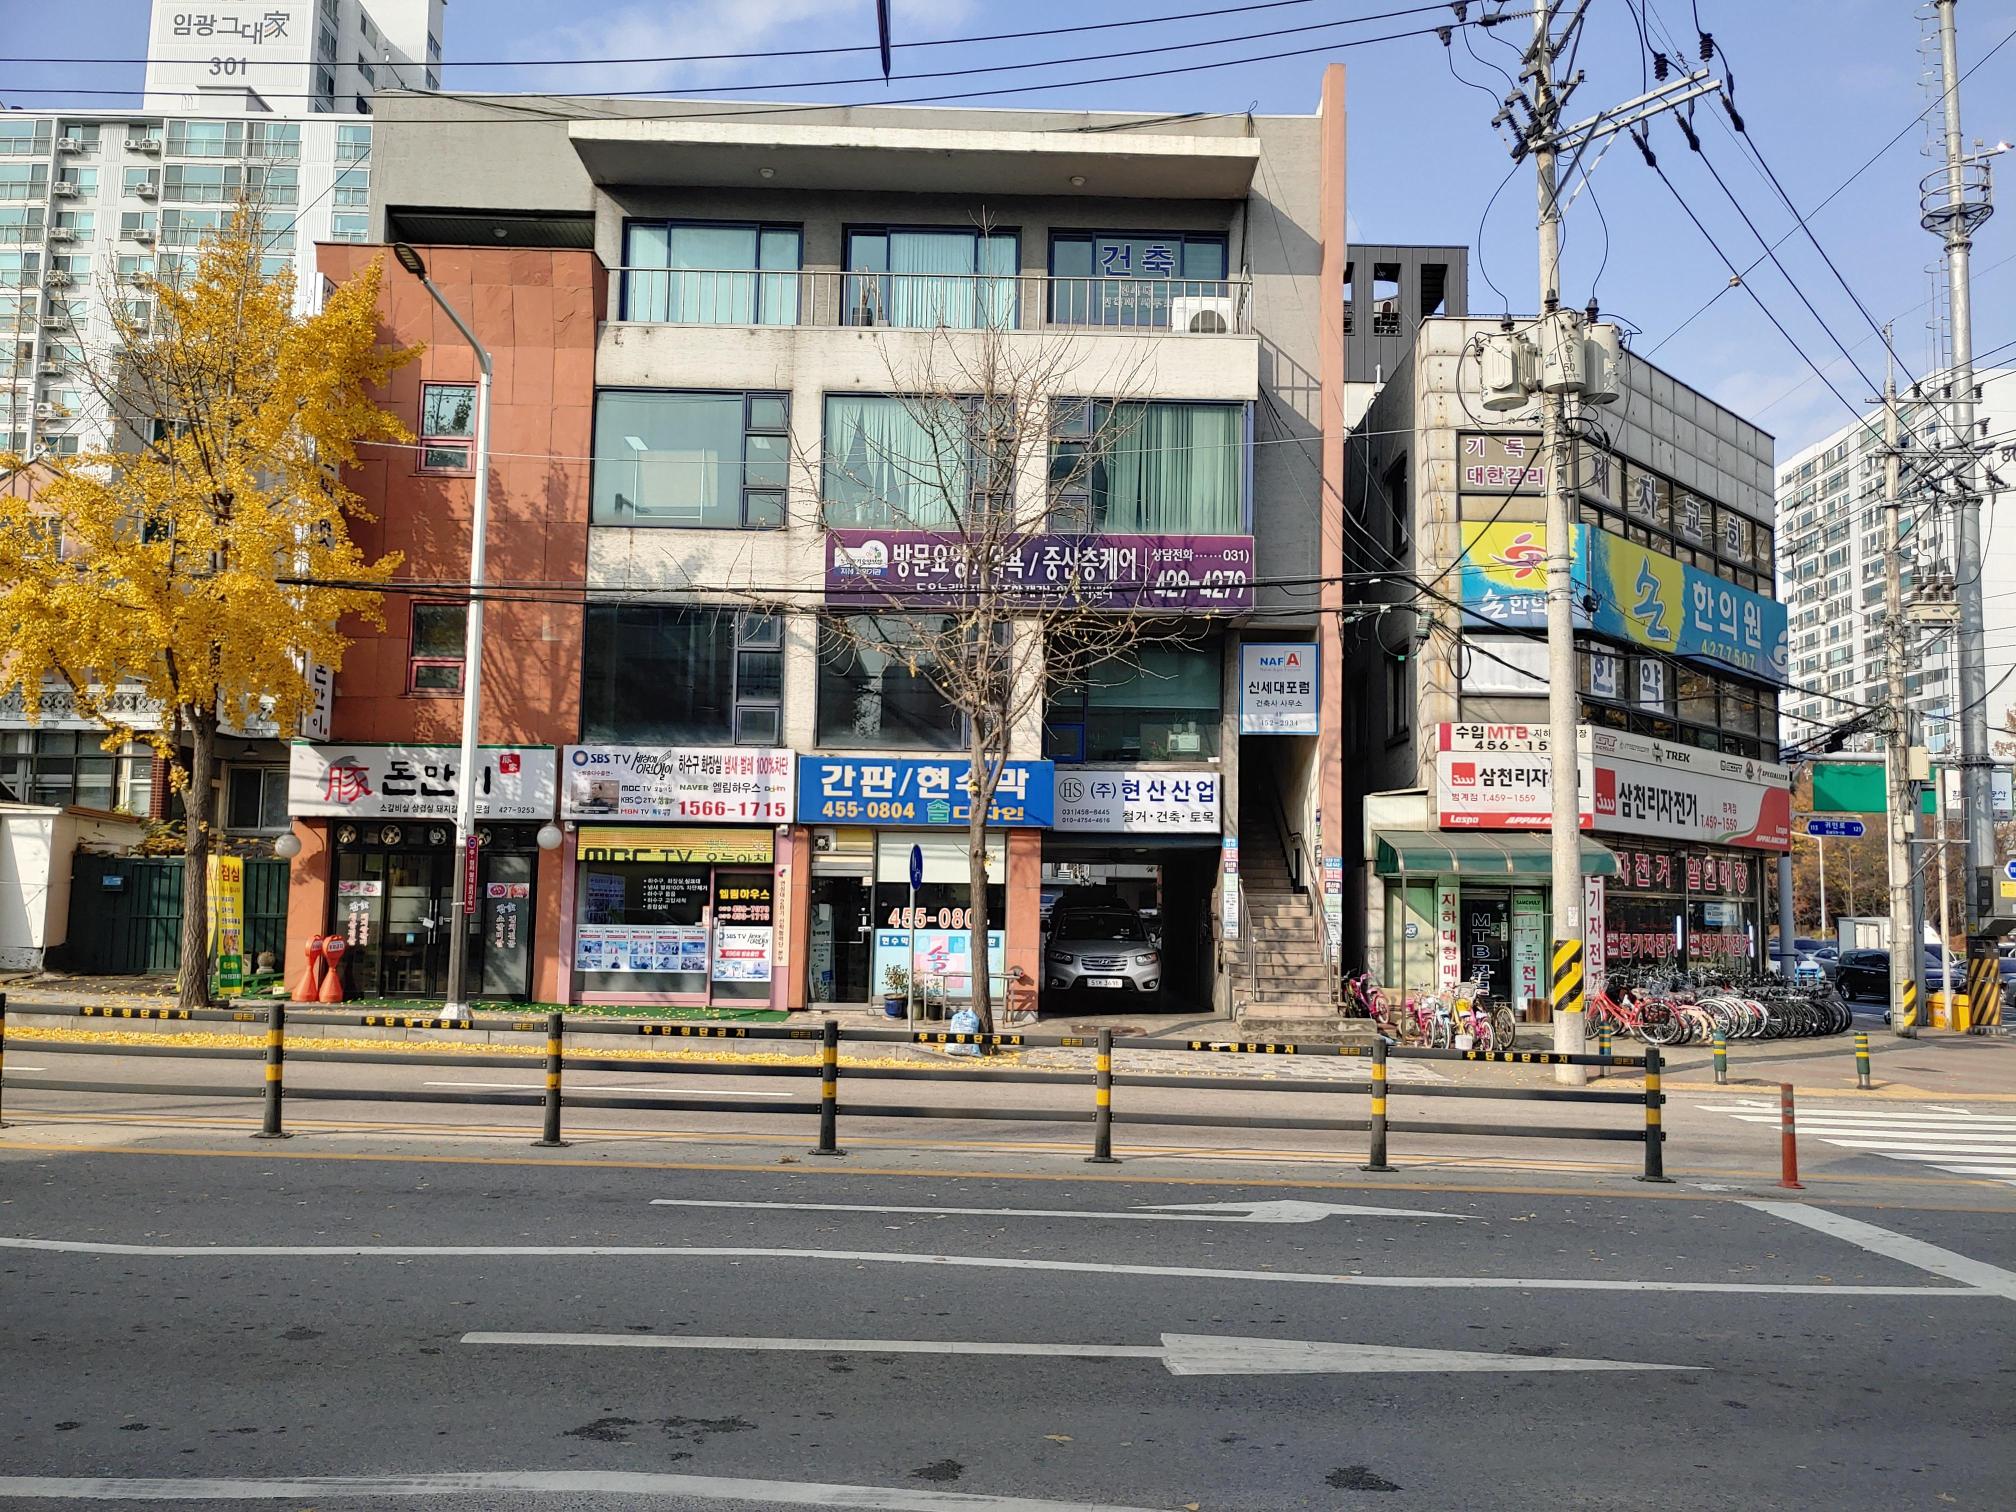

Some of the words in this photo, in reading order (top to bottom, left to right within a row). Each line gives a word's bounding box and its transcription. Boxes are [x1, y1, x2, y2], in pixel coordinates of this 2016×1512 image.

[209, 56, 247, 76] 301
[1100, 243, 1175, 279] 건축
[1151, 548, 1194, 561] 상담전화
[1152, 569, 1247, 599] 429-4279
[1509, 595, 1549, 615] 한의
[1691, 580, 1762, 650] 한의원
[1259, 652, 1300, 667] NAFA
[1248, 681, 1310, 695] 신세대포럼
[1280, 699, 1303, 708] 사무소
[1487, 726, 1529, 740] MTB
[590, 753, 611, 764] SBS
[613, 754, 631, 764] TV
[1665, 749, 1691, 763] TREK
[678, 754, 699, 775] 하수구
[700, 754, 722, 775] 화장실
[724, 755, 738, 775] 냄새
[740, 756, 754, 776] 벌레
[712, 782, 761, 794] 엘림하우스
[1062, 783, 1082, 798] HS
[1090, 782, 1117, 799] (주)
[1121, 779, 1214, 803] 현산산업
[620, 796, 634, 804] KBS
[678, 800, 786, 817] 1566-1715
[1618, 782, 1698, 828] 삼천리자전거
[498, 806, 536, 814] 427-9253
[821, 800, 915, 818] 455-0804
[1700, 813, 1738, 831] T.459-1559
[1687, 856, 1748, 894] 할인매장
[719, 889, 770, 900] 엘림하우스
